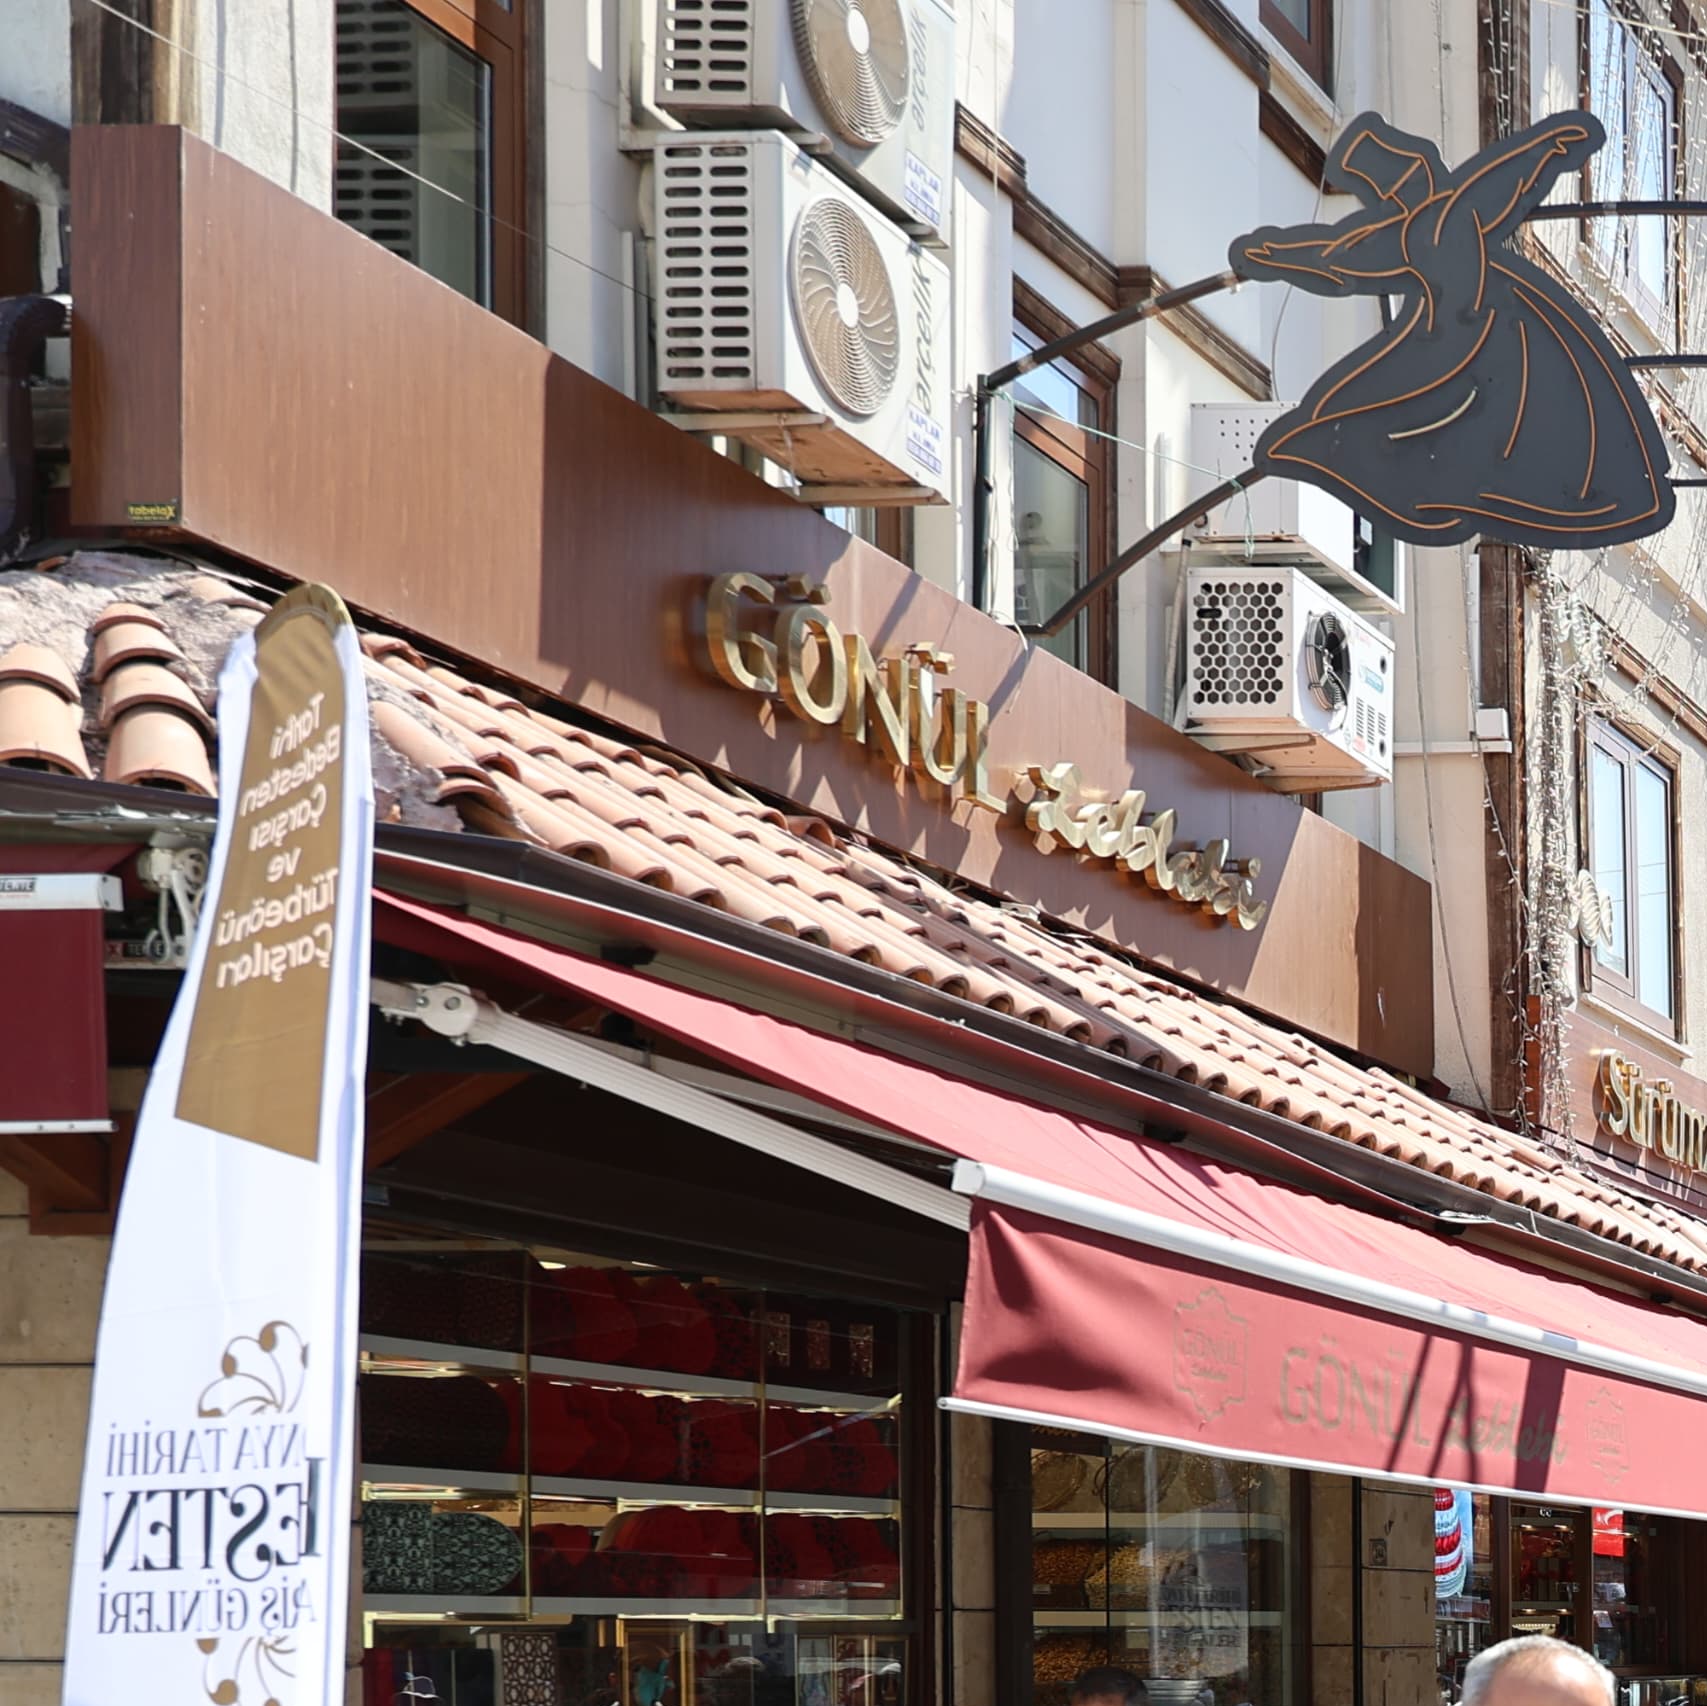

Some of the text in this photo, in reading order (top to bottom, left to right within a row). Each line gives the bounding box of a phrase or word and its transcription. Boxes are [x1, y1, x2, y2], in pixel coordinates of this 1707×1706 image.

[707, 573, 1007, 814] GÖNÜL
[1280, 1335, 1567, 1465] GÖNÜL Leblebi
